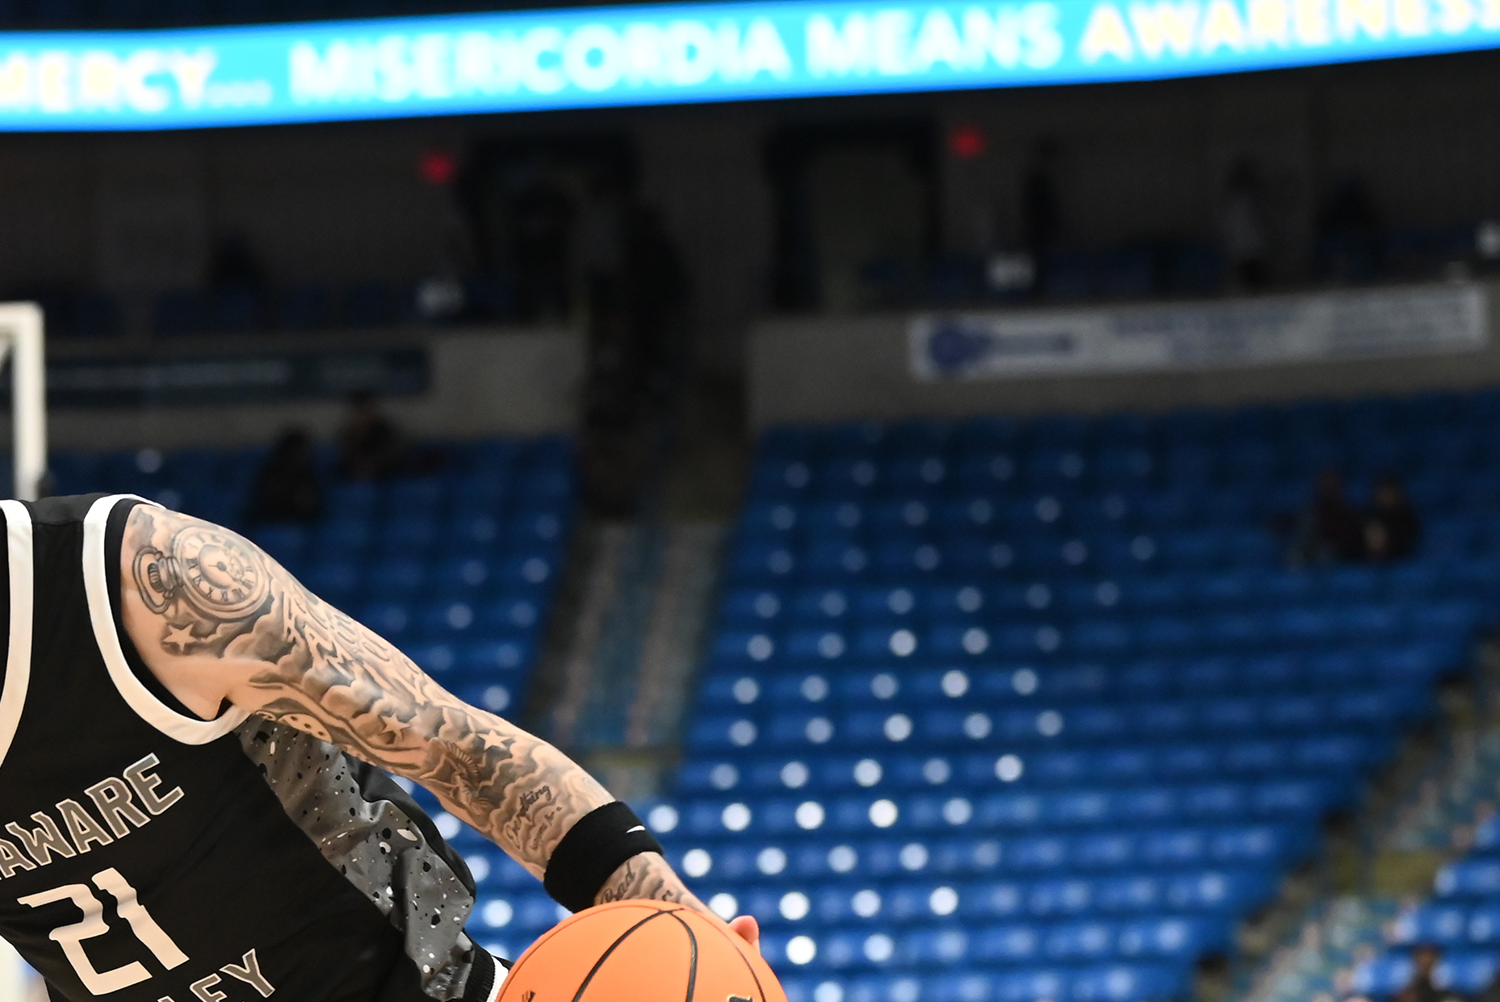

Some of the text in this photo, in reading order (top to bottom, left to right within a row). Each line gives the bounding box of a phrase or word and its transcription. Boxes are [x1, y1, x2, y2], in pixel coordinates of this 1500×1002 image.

[290, 19, 792, 102] MISERICORDIA
[805, 3, 1063, 78] MEANS
[16, 867, 190, 996] 21
